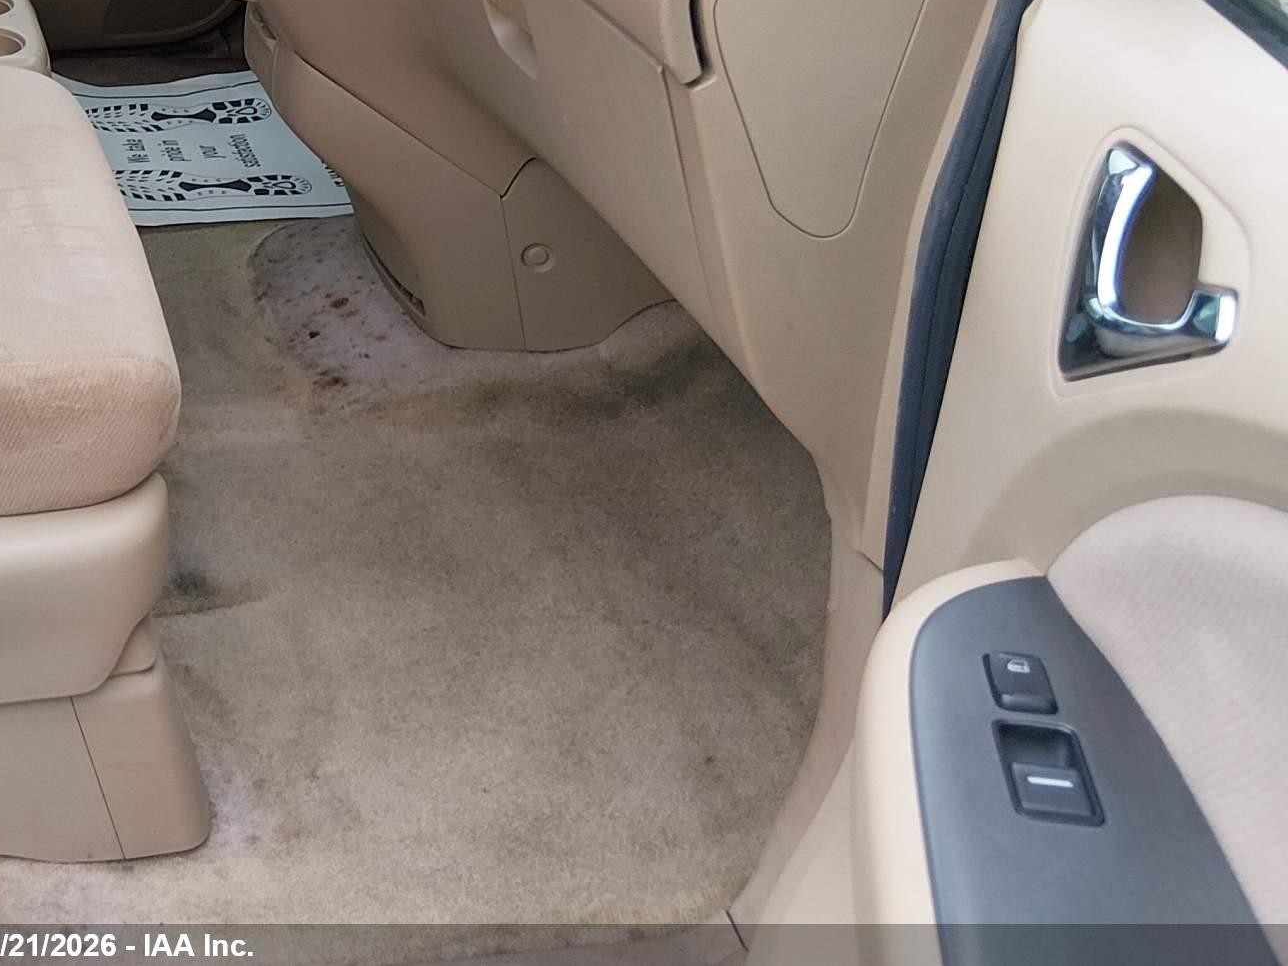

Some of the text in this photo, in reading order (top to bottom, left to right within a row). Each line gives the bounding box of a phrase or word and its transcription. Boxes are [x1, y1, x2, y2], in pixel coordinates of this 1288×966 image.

[122, 138, 150, 164] We take
[160, 146, 192, 162] pride
[199, 144, 226, 159] your
[227, 133, 261, 168] satisfaction
